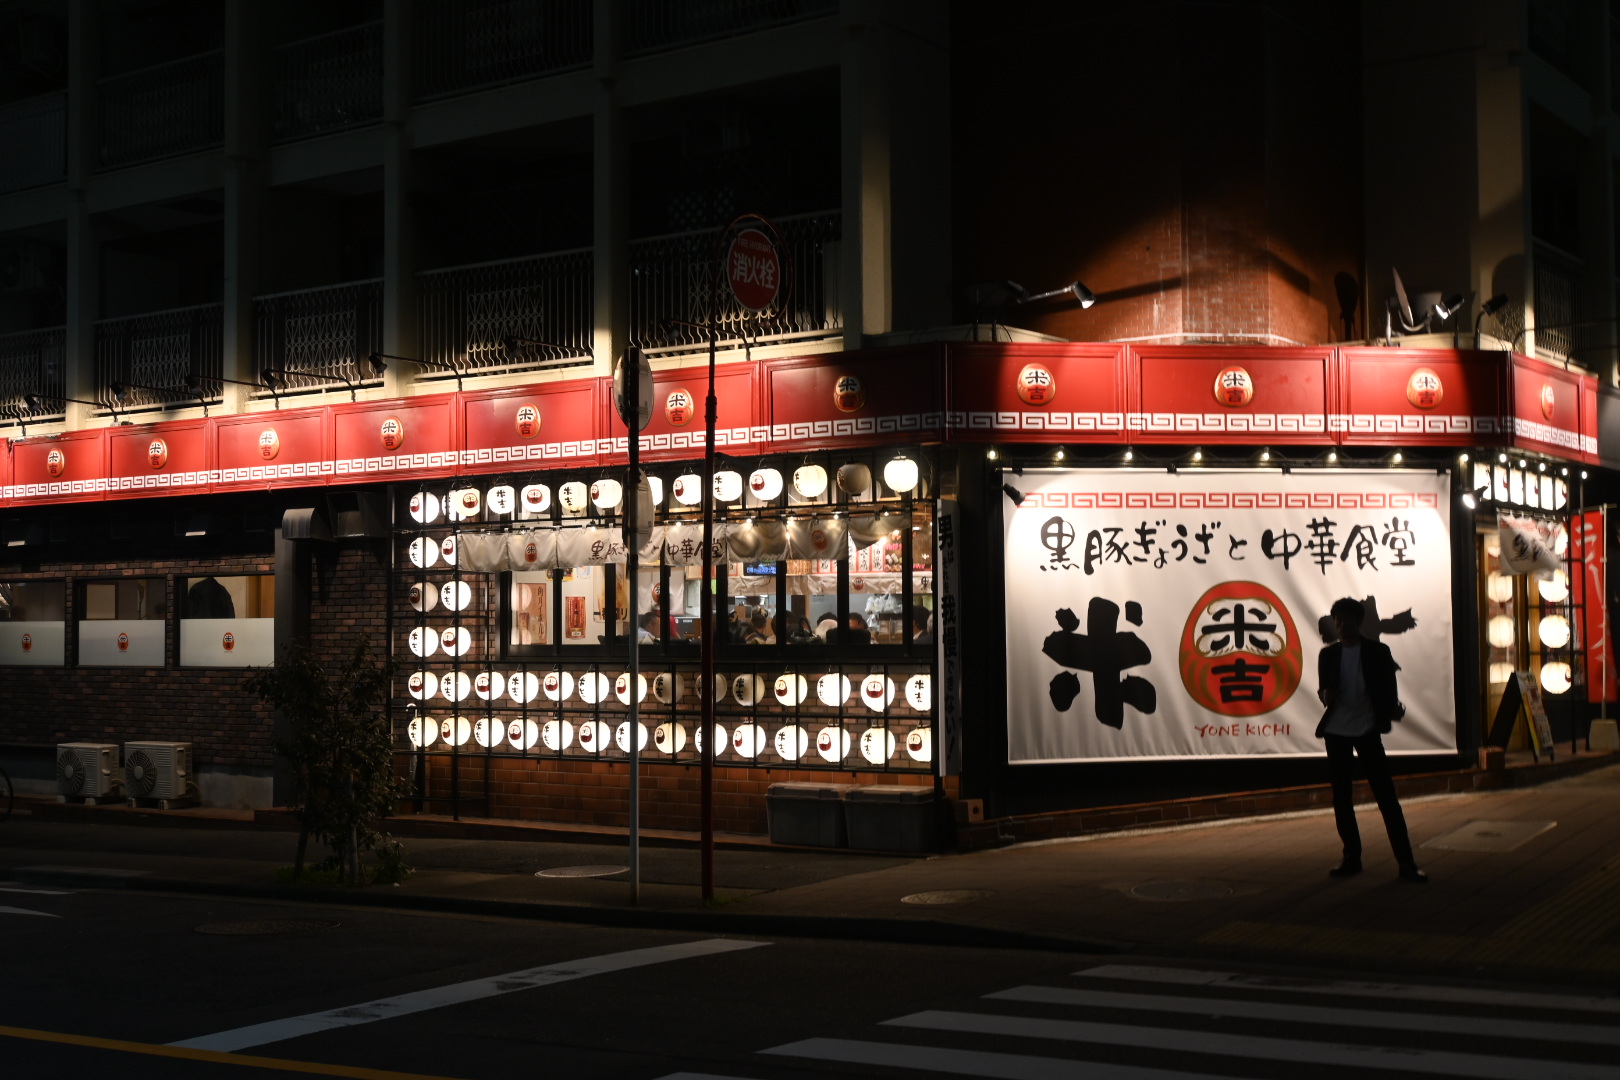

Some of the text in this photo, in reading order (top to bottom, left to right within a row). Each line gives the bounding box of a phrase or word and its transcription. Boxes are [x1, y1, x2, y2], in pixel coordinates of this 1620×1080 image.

[737, 238, 749, 248] FIRE
[732, 251, 776, 289] 消火栓
[1026, 369, 1048, 400] 米吉
[1224, 371, 1245, 403] 米吉
[669, 393, 686, 421] 米吉
[383, 421, 396, 447] 米吉
[519, 408, 534, 436] 米吉
[1042, 595, 1157, 729] 米
[1201, 602, 1276, 704] 米吉
[1194, 723, 1291, 738] YONE KICHI
